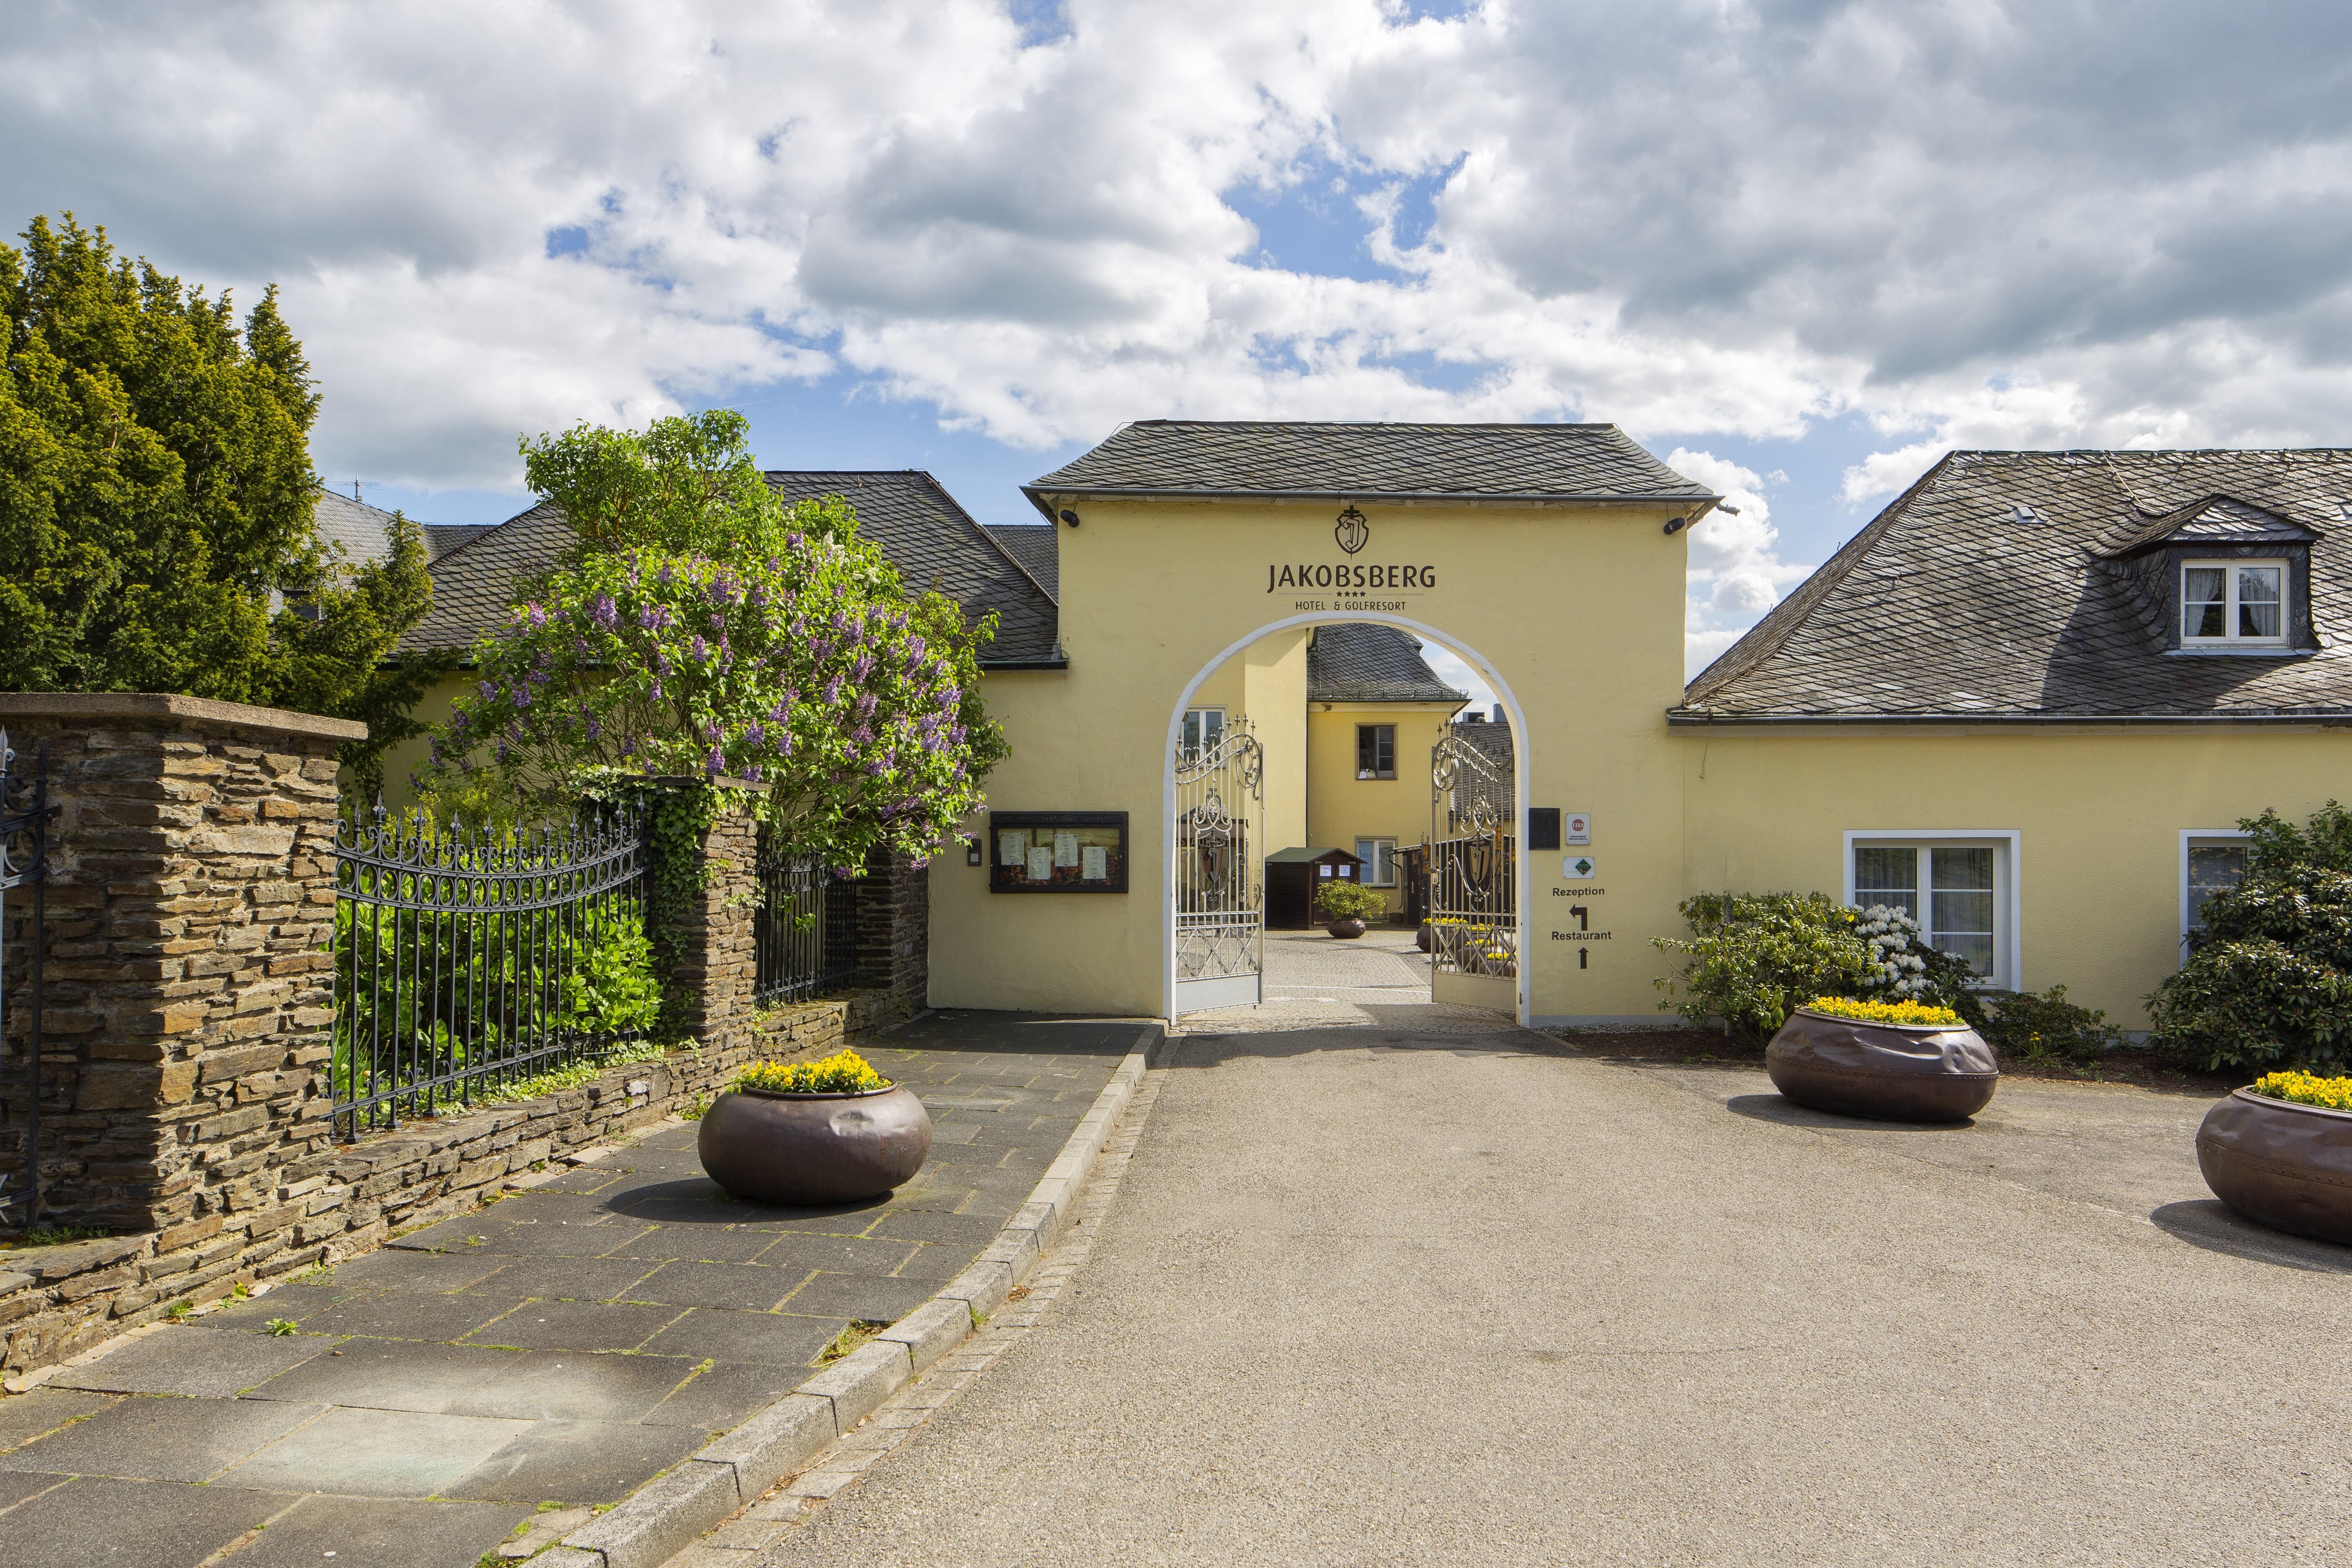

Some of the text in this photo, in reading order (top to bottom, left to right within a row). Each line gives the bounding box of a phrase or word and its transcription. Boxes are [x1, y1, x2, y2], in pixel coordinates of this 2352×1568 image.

[1267, 564, 1436, 594] JAKOBSBERG
[1295, 601, 1406, 610] HOTEL & GOLFRESORT
[1552, 887, 1605, 898] Rezeption
[1552, 931, 1612, 941] Restaurant
